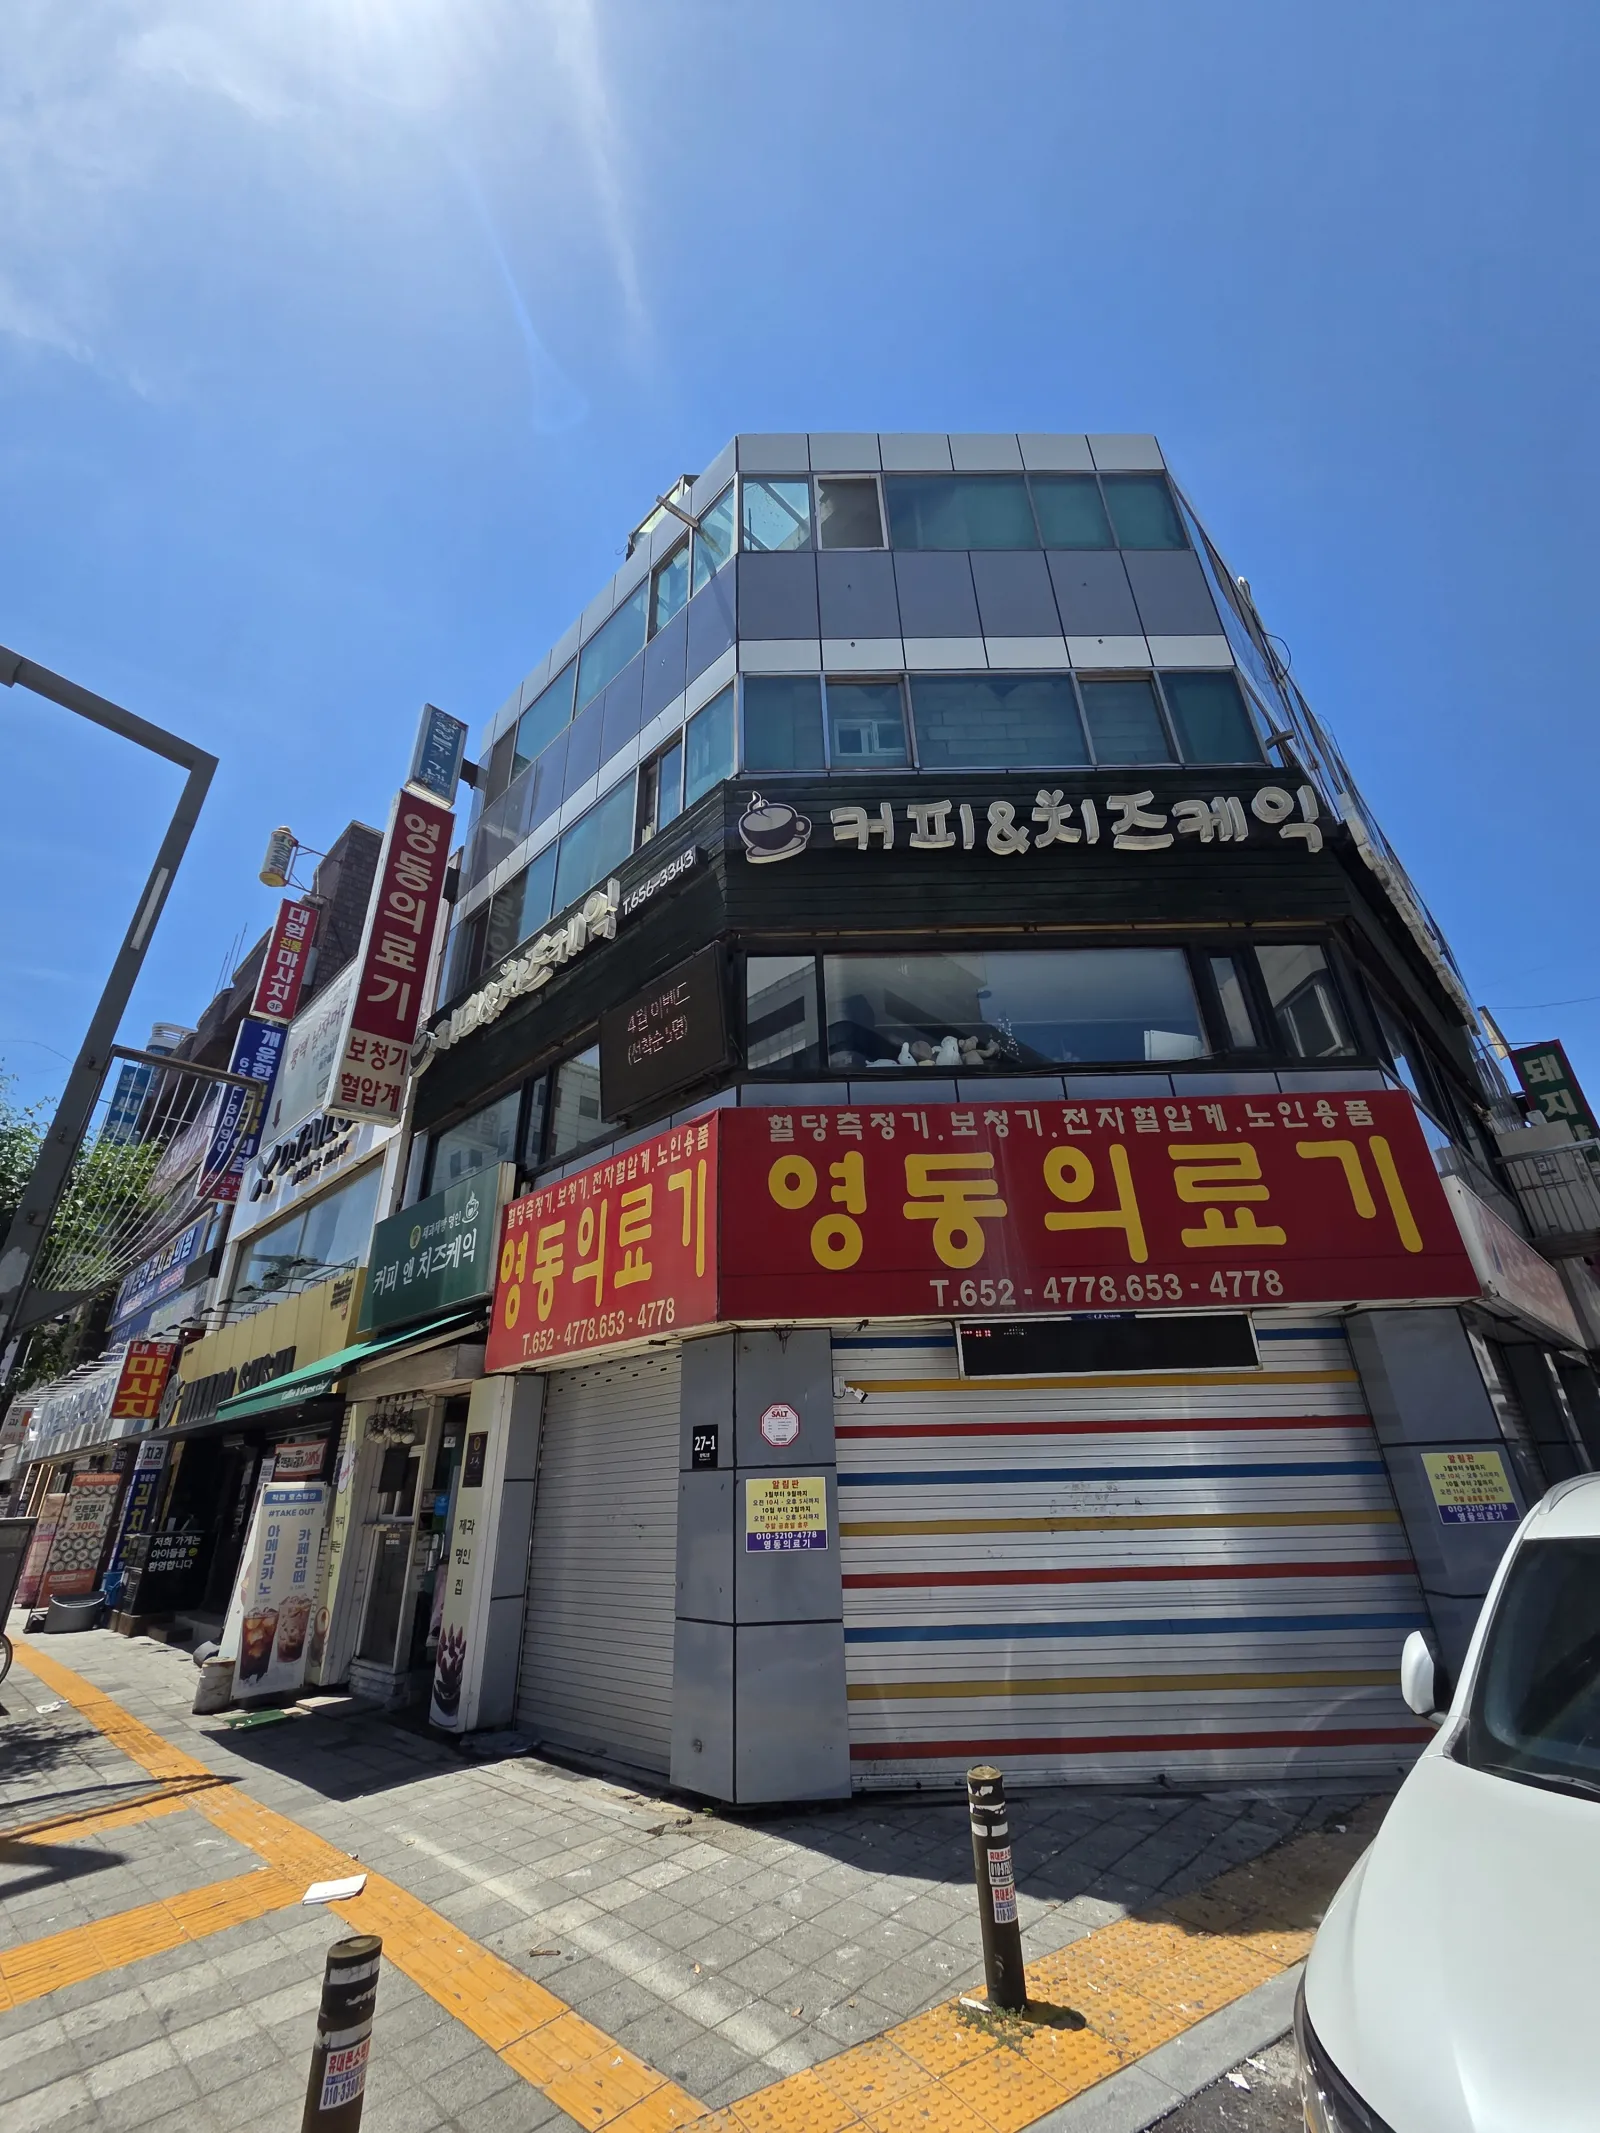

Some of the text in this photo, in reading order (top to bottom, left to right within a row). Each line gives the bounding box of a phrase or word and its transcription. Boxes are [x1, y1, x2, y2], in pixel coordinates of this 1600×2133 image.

[830, 785, 1323, 856] 커피&치즈케익
[622, 849, 695, 916] T.656-3343
[366, 813, 440, 1021] 영동의료기
[267, 906, 310, 1001] 대원 전통 마사지
[269, 1002, 282, 1011] 3F
[252, 1029, 281, 1081] 개운한
[345, 1036, 408, 1076] 보청기
[341, 1072, 401, 1112] 혈압계
[768, 1136, 1423, 1270] 영동의료기
[500, 1159, 706, 1330] 영동의료기
[373, 1261, 399, 1295] 커피
[403, 1256, 415, 1285] 앤
[417, 1228, 477, 1279] 치즈케익
[132, 1342, 170, 1356] 대원
[114, 1357, 167, 1418] 마사지
[771, 1410, 789, 1418] SALT
[695, 1435, 715, 1451] 27-1
[145, 1446, 164, 1459] 치과
[1448, 1454, 1475, 1463] 알림판
[772, 1480, 799, 1489] 알림판
[268, 1509, 296, 1517] #TAKE
[1448, 1503, 1508, 1512] 010-5210-4778
[1457, 1511, 1504, 1522] 영동의료기
[154, 1535, 201, 1547] 저희 가게는
[756, 1531, 817, 1540] 010-5210-4778
[763, 1539, 810, 1550] 영동의료기
[151, 1548, 187, 1559] 아이들을
[258, 1525, 281, 1595] 아메리카노
[292, 1528, 311, 1583] 카페라떼
[455, 1548, 471, 1565] 명인
[148, 1561, 193, 1573] 환영합니다
